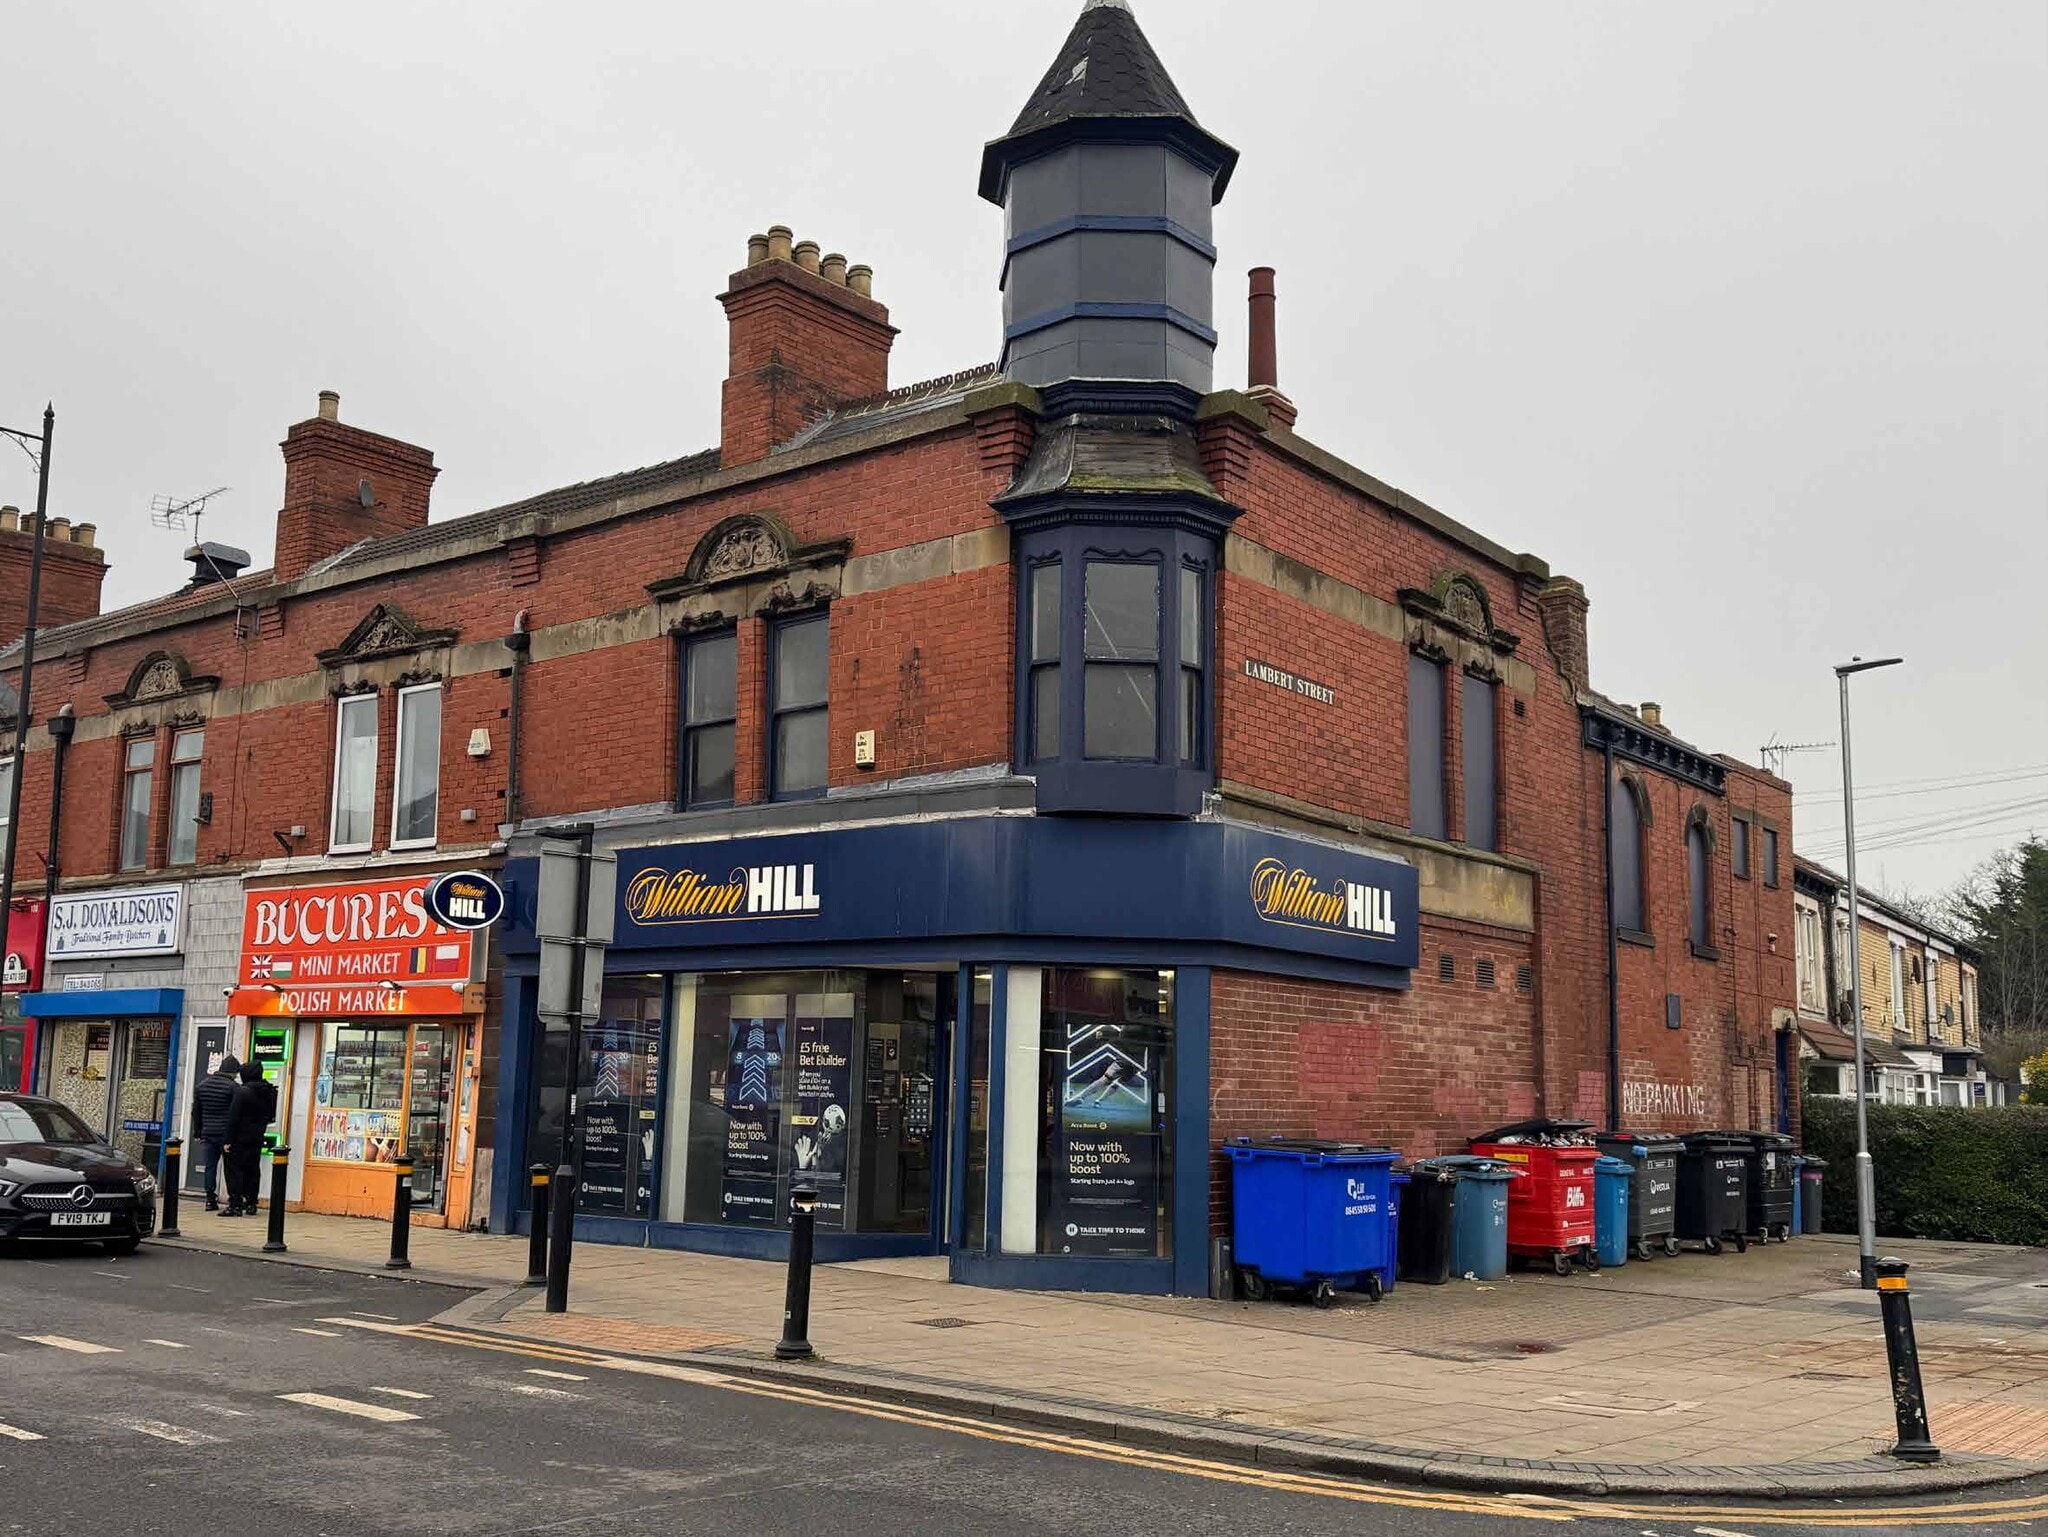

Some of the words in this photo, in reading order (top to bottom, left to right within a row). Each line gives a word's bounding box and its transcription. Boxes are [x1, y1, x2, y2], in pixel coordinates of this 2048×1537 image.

[1245, 660, 1294, 690] LAMBERT
[1297, 679, 1335, 705] STREET
[625, 866, 749, 925] William
[748, 864, 820, 913] HILL
[1250, 857, 1348, 928] William
[1347, 883, 1396, 935] HILL
[53, 905, 77, 930] S.J.
[81, 896, 174, 929] DONALDSONS
[449, 897, 486, 919] HILL
[299, 956, 333, 977] MINI
[336, 952, 402, 976] MARKET
[278, 990, 331, 1013] POLISH
[338, 989, 408, 1012] MARKET
[800, 1042, 811, 1053] £5
[812, 1041, 830, 1053] free
[800, 1055, 815, 1066] Bet
[816, 1055, 847, 1066] Builder
[1623, 1080, 1642, 1115] NO
[730, 1120, 747, 1130] Now
[747, 1120, 763, 1131] with
[729, 1132, 739, 1141] up
[740, 1131, 747, 1139] to
[748, 1131, 768, 1141] 100%
[728, 1140, 749, 1150] boost
[1070, 1141, 1096, 1152] Now
[1097, 1141, 1123, 1153] with
[1070, 1154, 1084, 1165] up
[1085, 1153, 1098, 1163] to
[1100, 1153, 1131, 1164] 100%
[1070, 1163, 1102, 1174] boost
[57, 1213, 83, 1224] FV19
[86, 1213, 105, 1224] TKJ
